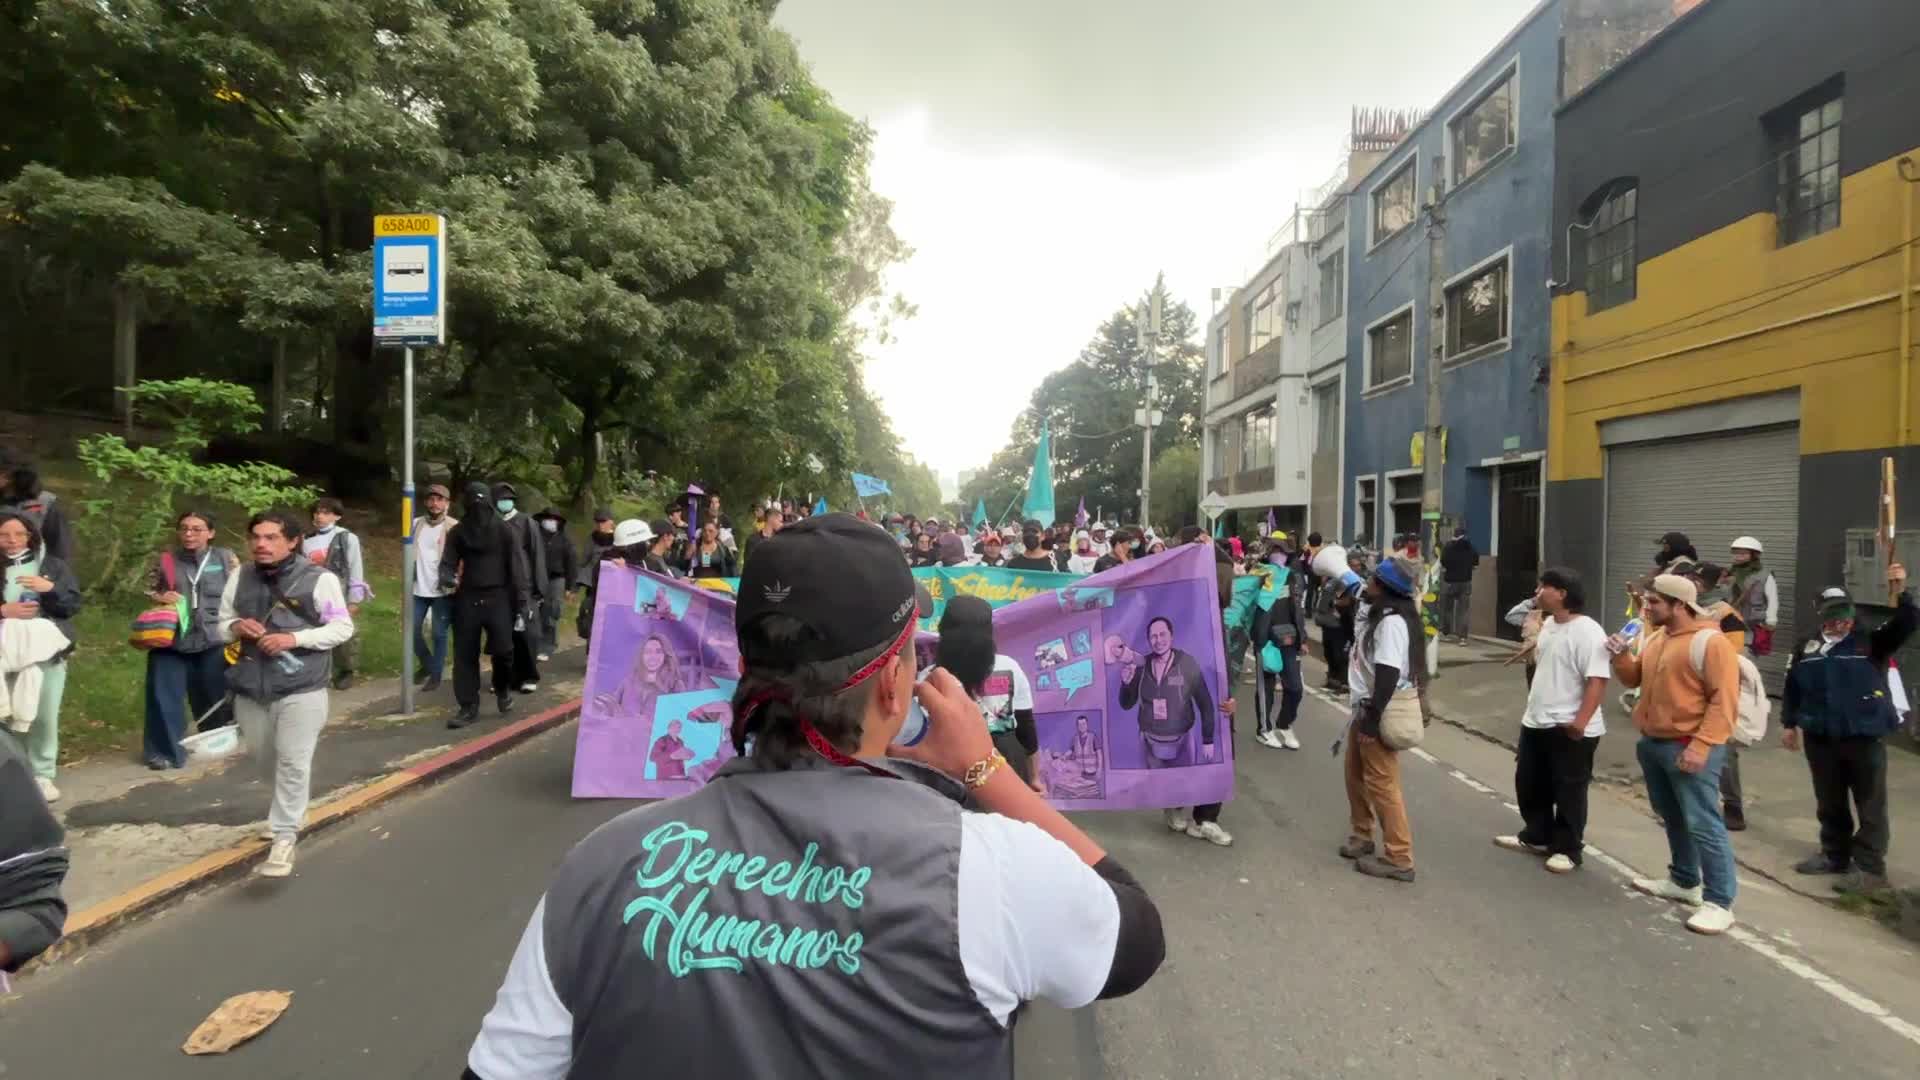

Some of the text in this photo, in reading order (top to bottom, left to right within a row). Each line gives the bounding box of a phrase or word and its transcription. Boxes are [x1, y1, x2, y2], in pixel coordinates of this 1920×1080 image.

[382, 218, 430, 232] 658A00
[636, 821, 872, 909] Derechos
[622, 882, 865, 978] Humanos
